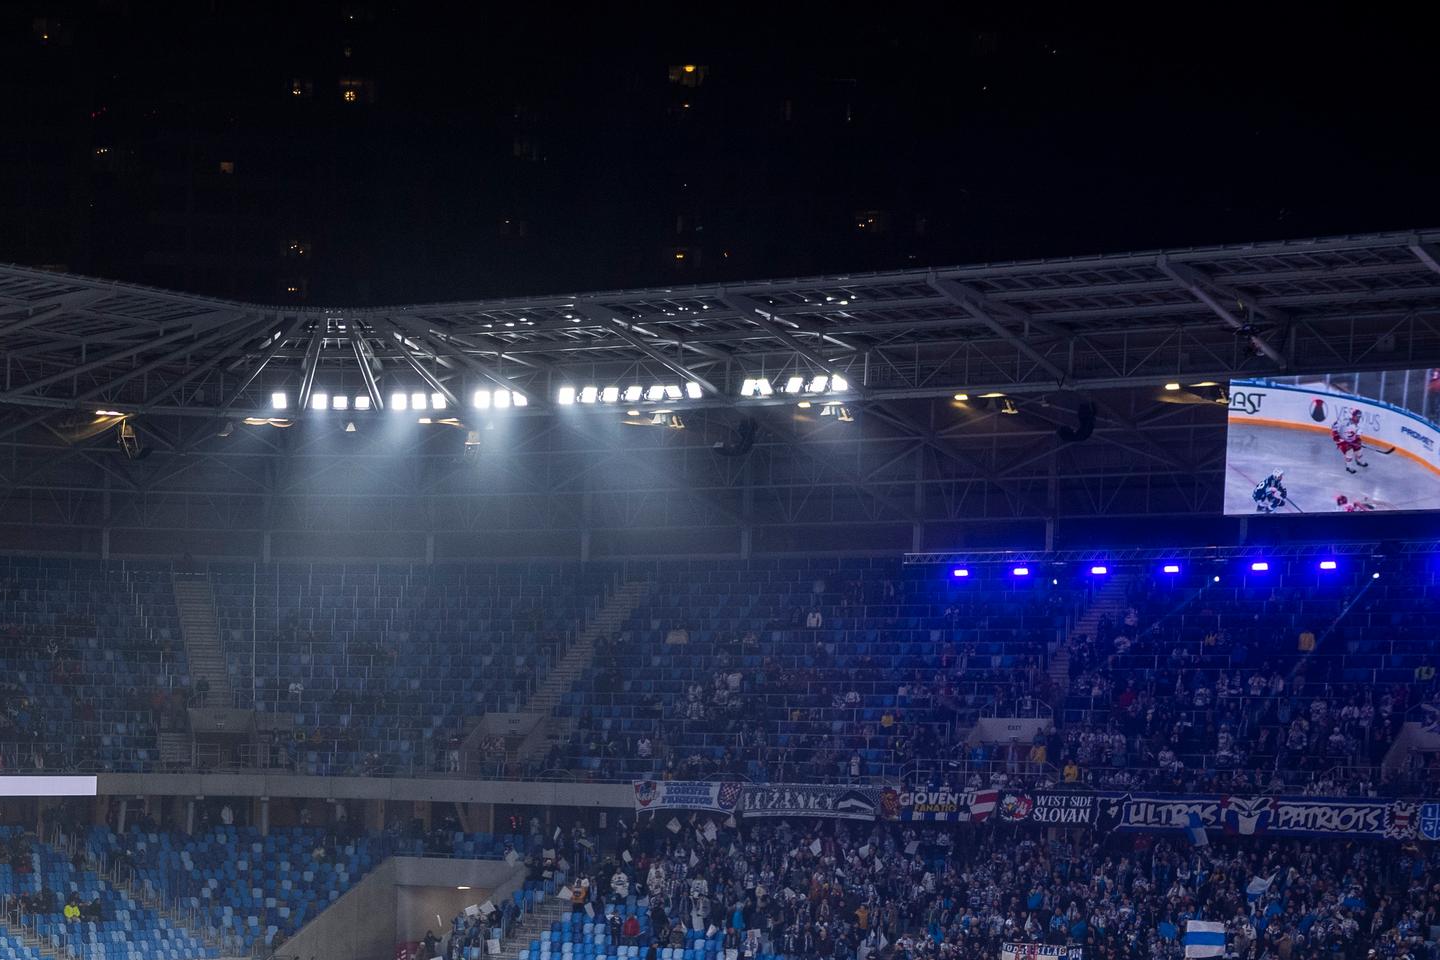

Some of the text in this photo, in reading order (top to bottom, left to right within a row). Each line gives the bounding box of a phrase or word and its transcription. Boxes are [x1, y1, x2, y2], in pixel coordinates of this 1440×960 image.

[1037, 795, 1094, 807] WEST SIDE
[1033, 807, 1090, 823] SLOVAN
[1278, 805, 1382, 831] PATRIOTS
